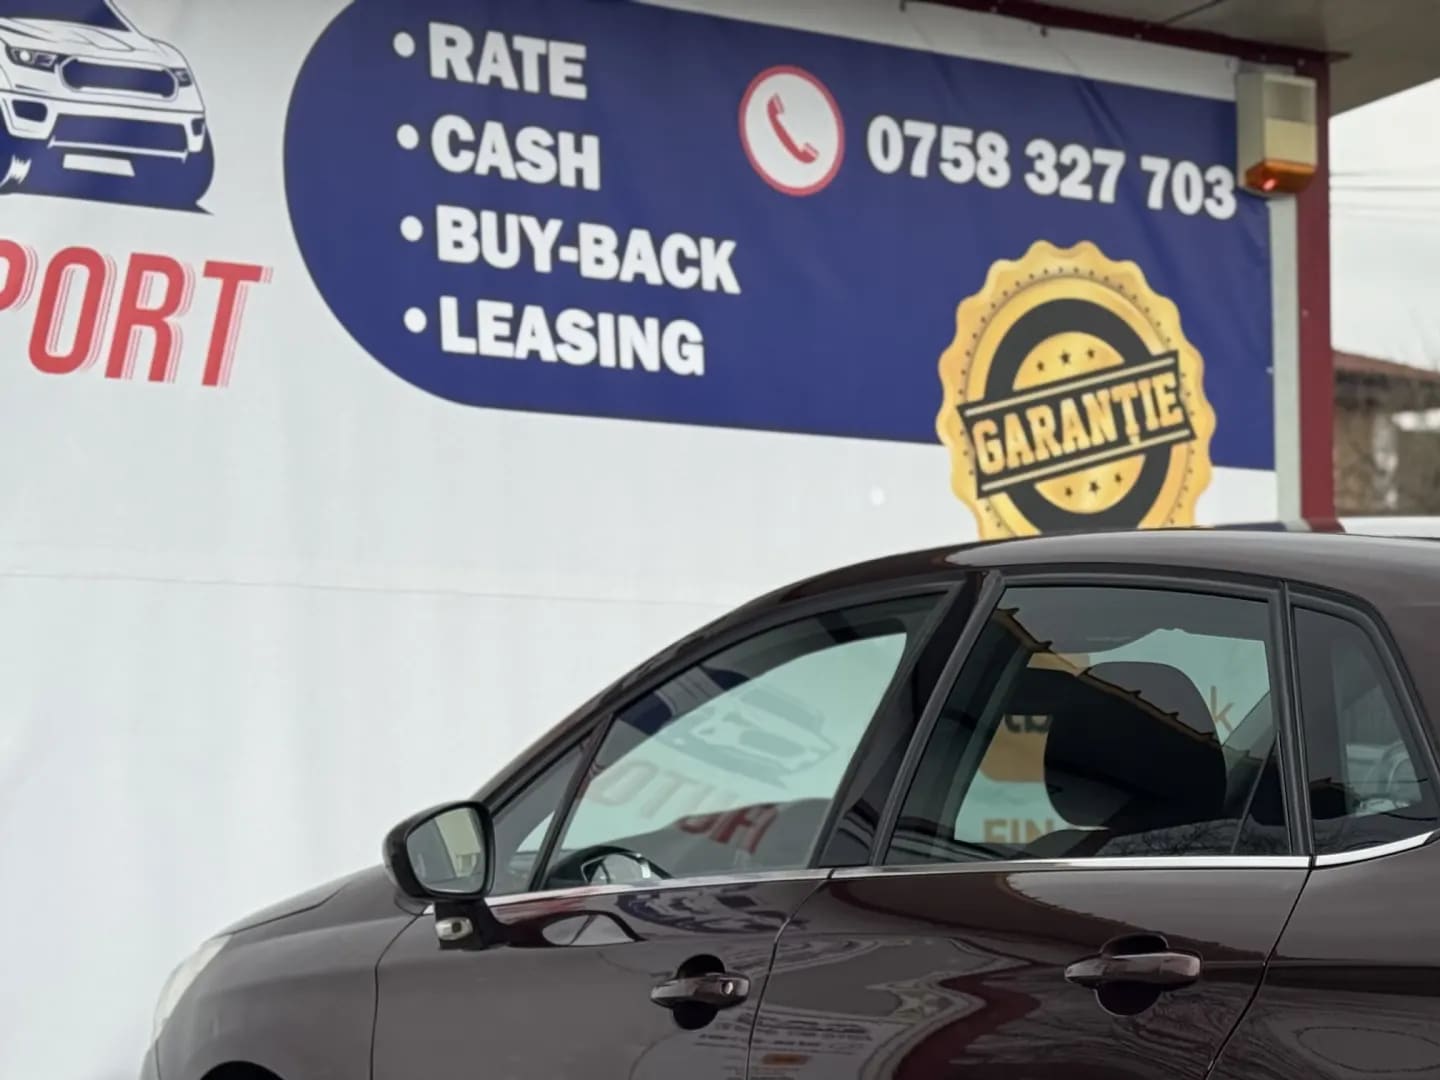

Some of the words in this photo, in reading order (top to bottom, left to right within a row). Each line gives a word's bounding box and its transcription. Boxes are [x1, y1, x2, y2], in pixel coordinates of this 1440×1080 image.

[428, 22, 588, 100] RATE
[430, 114, 601, 191] CASH
[866, 114, 1011, 189] 0758
[1024, 138, 1126, 204] 327
[1140, 155, 1237, 220] 703
[436, 205, 742, 294] BUY-BACK
[440, 297, 705, 376] LEASING
[971, 371, 1184, 475] GARANȚIE
